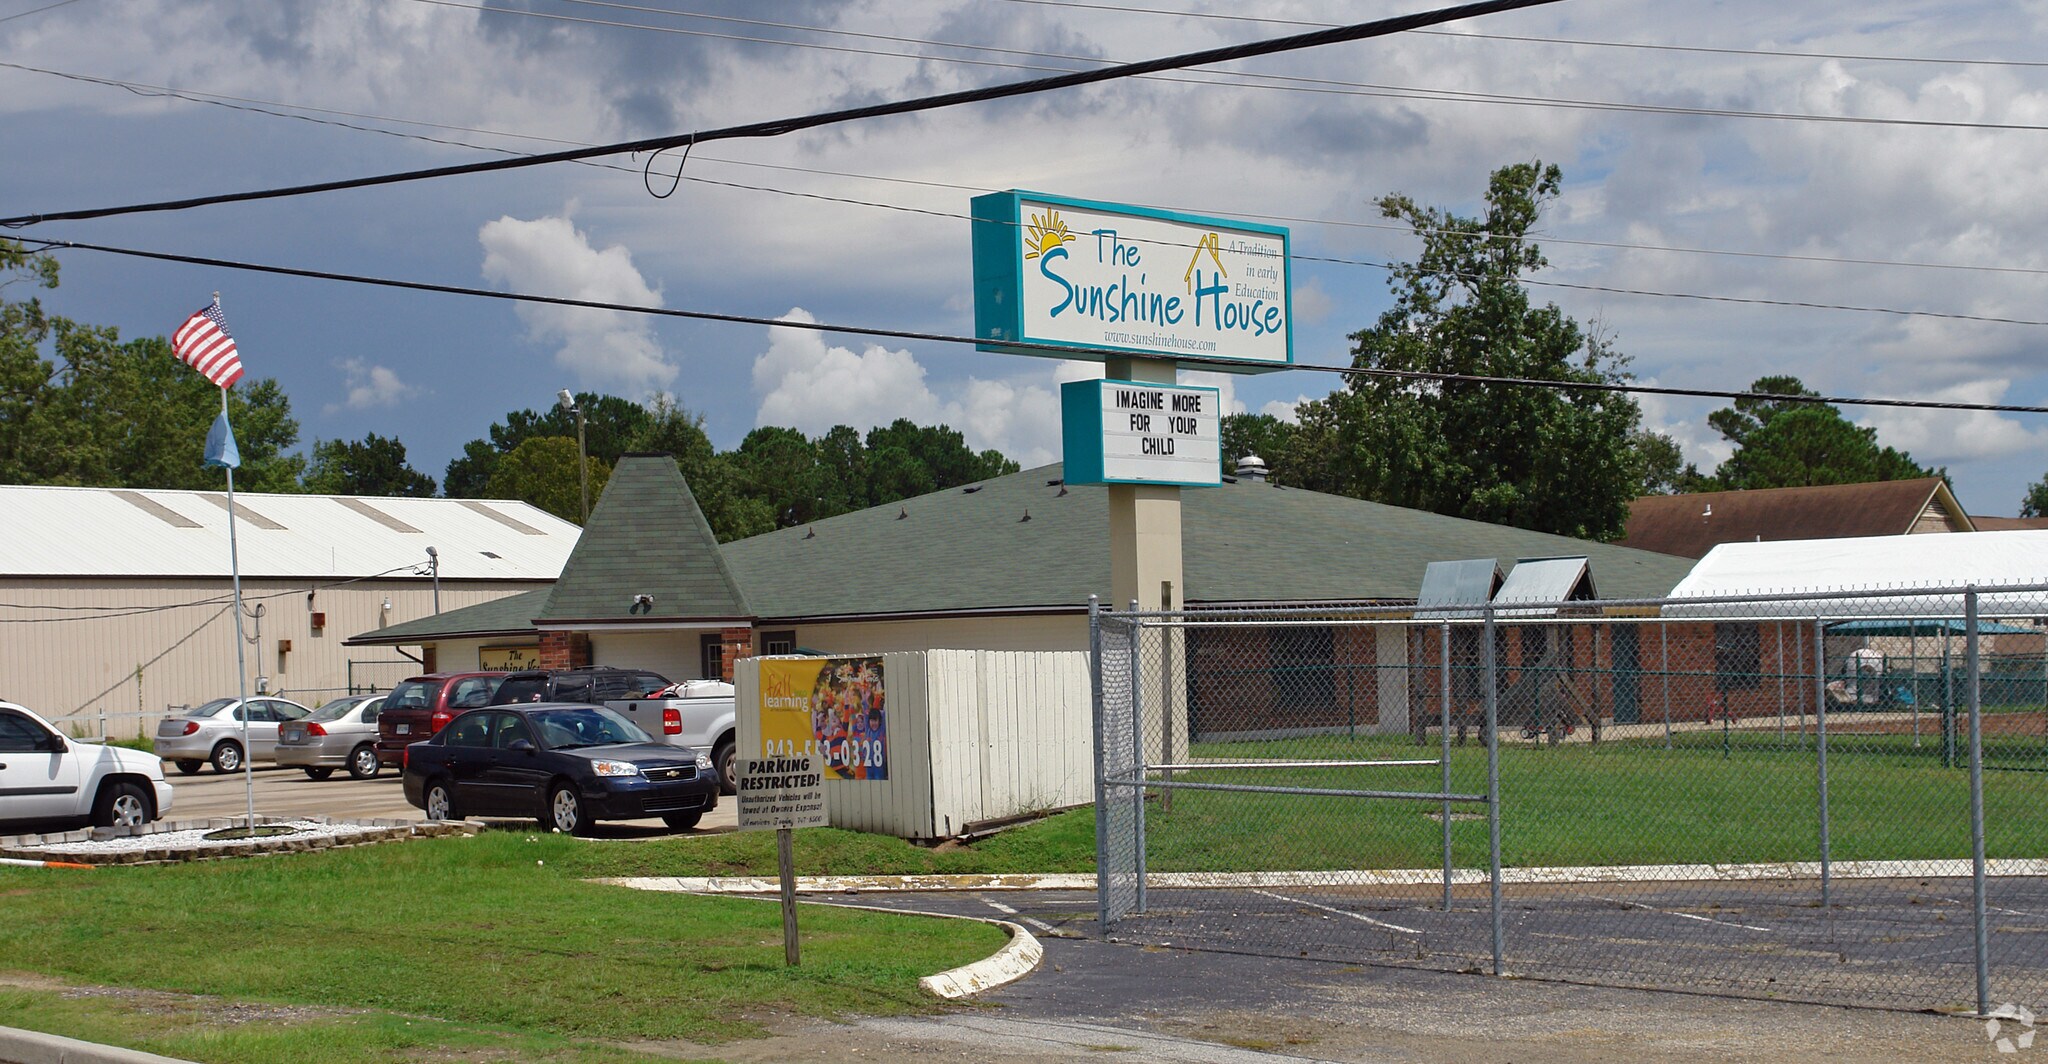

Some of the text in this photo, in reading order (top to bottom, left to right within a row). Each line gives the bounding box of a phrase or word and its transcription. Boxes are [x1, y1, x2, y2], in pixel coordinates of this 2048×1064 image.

[1092, 229, 1141, 267] The
[1228, 240, 1278, 260] A Tradition
[1246, 263, 1279, 284] in early
[1040, 247, 1283, 337] Sunshine House
[1235, 283, 1279, 301] Education
[1104, 330, 1217, 353] www.sunshinehouse.com
[1116, 390, 1201, 413] IMAGINE MORE
[1130, 413, 1198, 435] FOR YOUR
[1142, 437, 1175, 456] CHILD
[509, 650, 523, 660] The
[482, 661, 524, 671] Sunshine
[767, 673, 791, 698] fall
[764, 692, 809, 713] learning
[749, 757, 810, 774] PARKING
[740, 773, 820, 791] RESTRICTED!
[778, 793, 801, 802] Vehicles
[742, 806, 761, 815] towed
